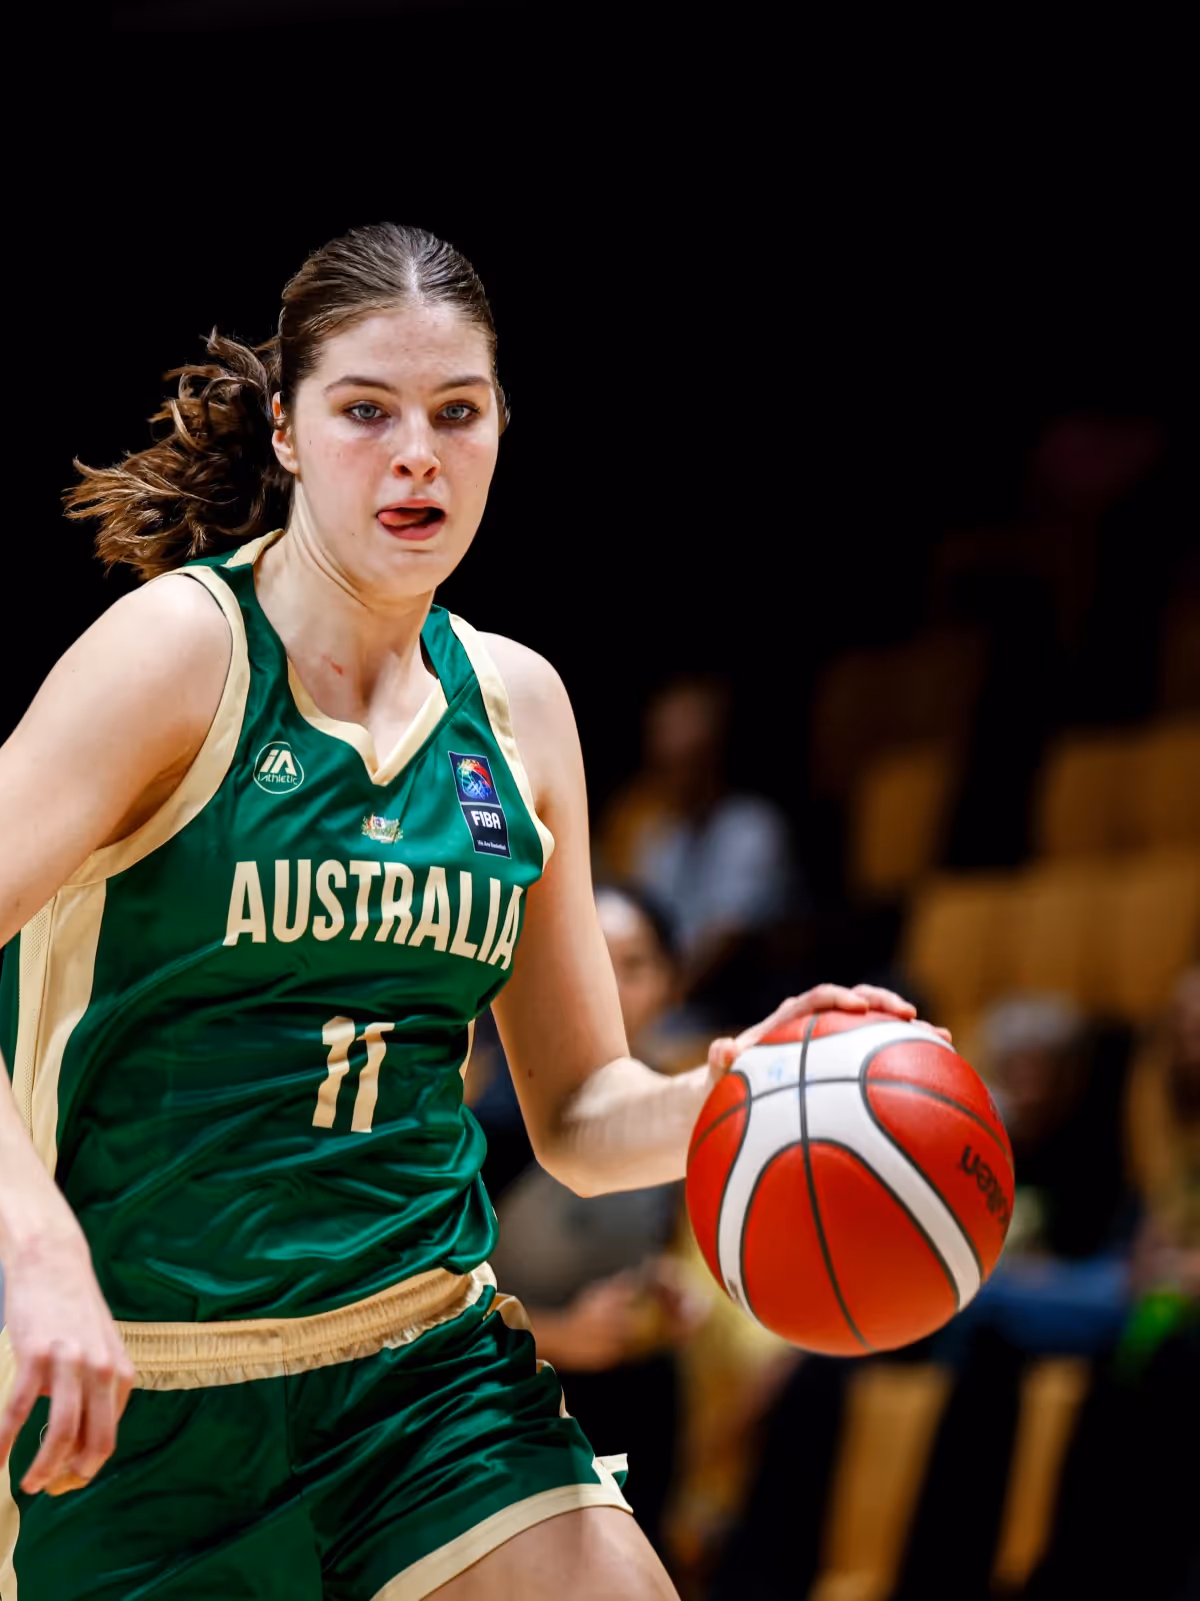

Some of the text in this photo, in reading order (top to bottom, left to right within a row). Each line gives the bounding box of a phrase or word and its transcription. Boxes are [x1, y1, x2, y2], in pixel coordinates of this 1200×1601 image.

[471, 810, 501, 829] FIBA
[222, 859, 524, 970] AUSTRALIA
[312, 1016, 395, 1133] 11
